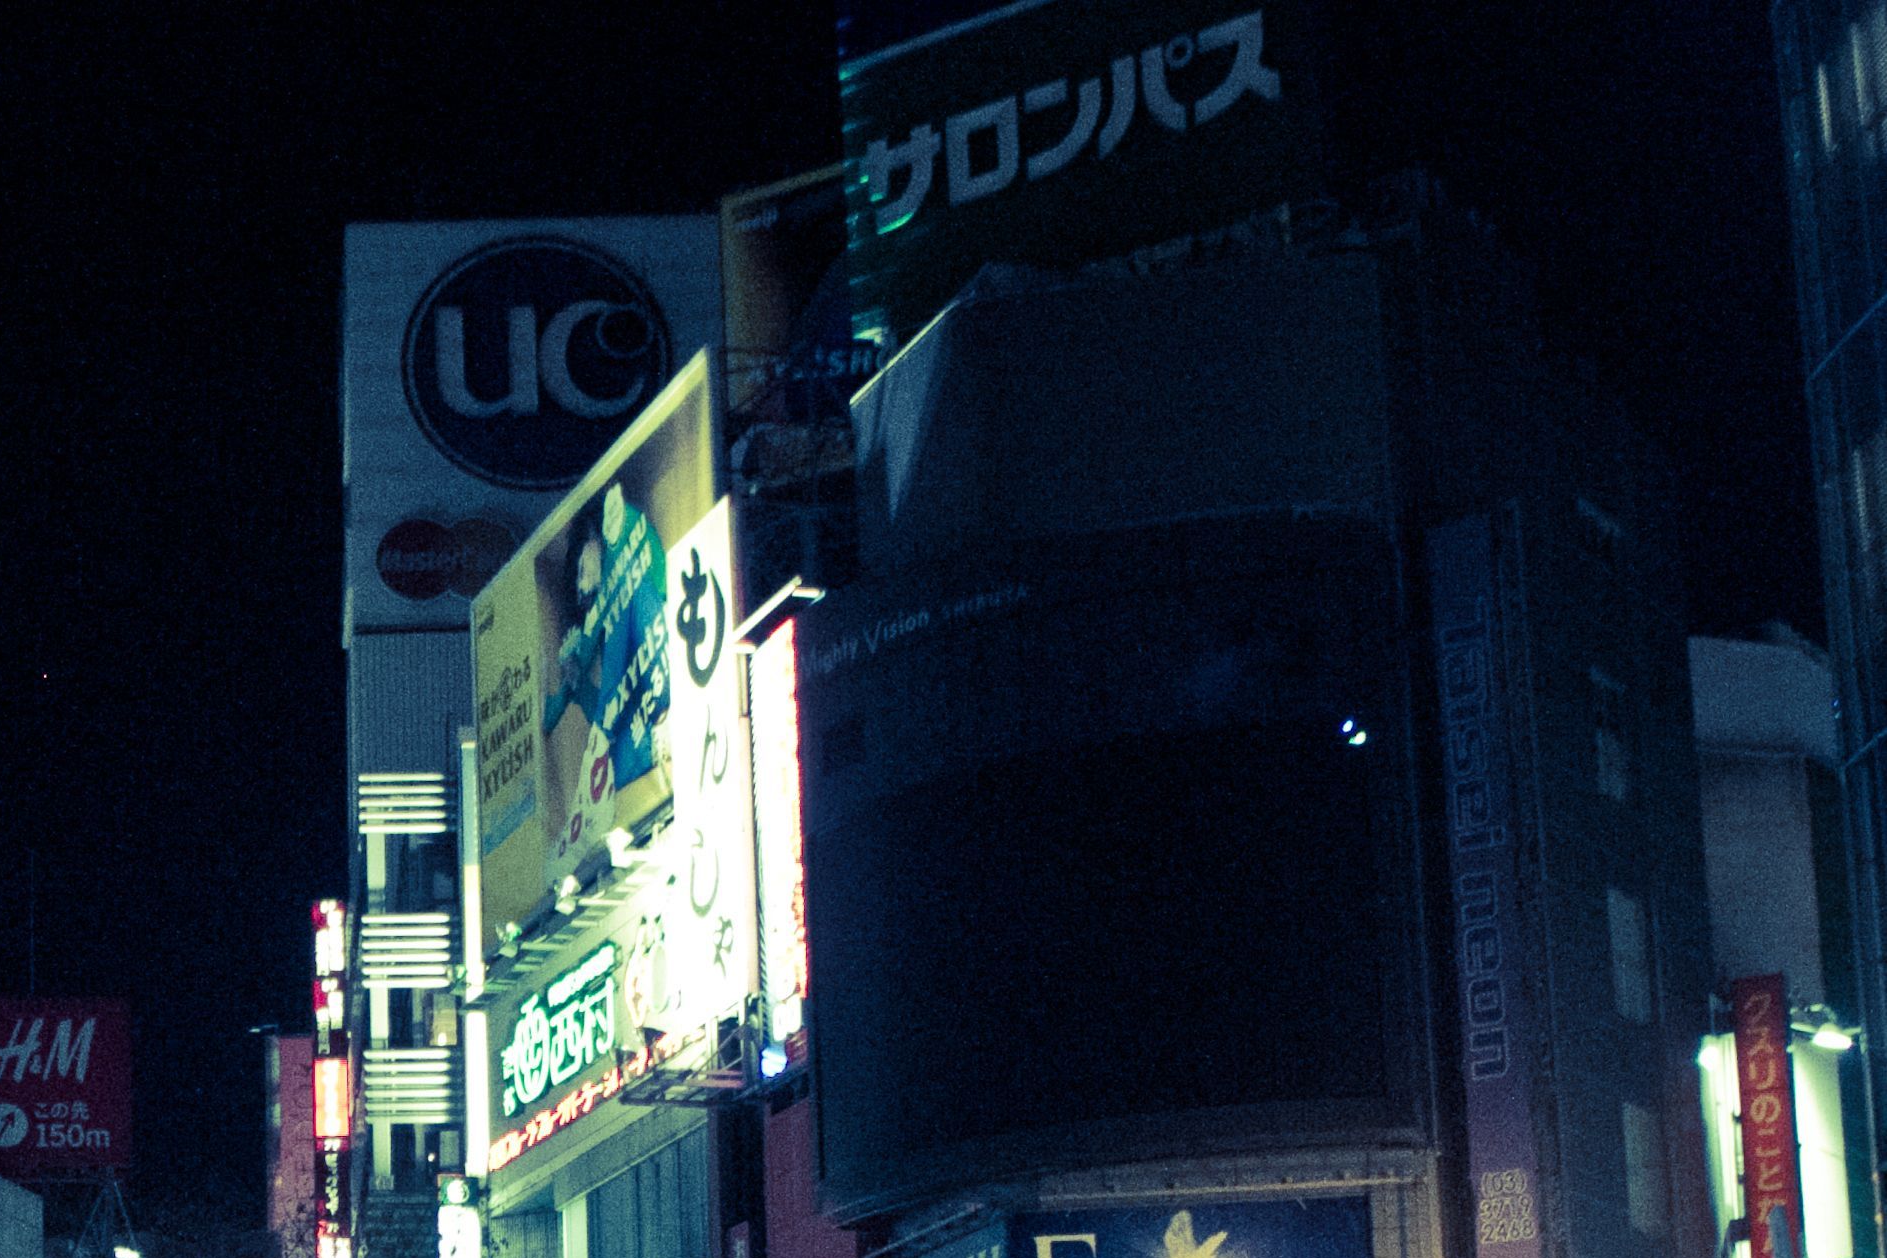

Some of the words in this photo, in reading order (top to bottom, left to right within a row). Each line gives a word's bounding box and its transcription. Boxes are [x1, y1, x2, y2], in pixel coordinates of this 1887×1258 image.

[866, 9, 1282, 237] サロンパス
[436, 300, 656, 419] UC
[482, 733, 536, 803] XYLISH
[1460, 868, 1511, 1082] neon
[33, 1122, 111, 1151] 150m
